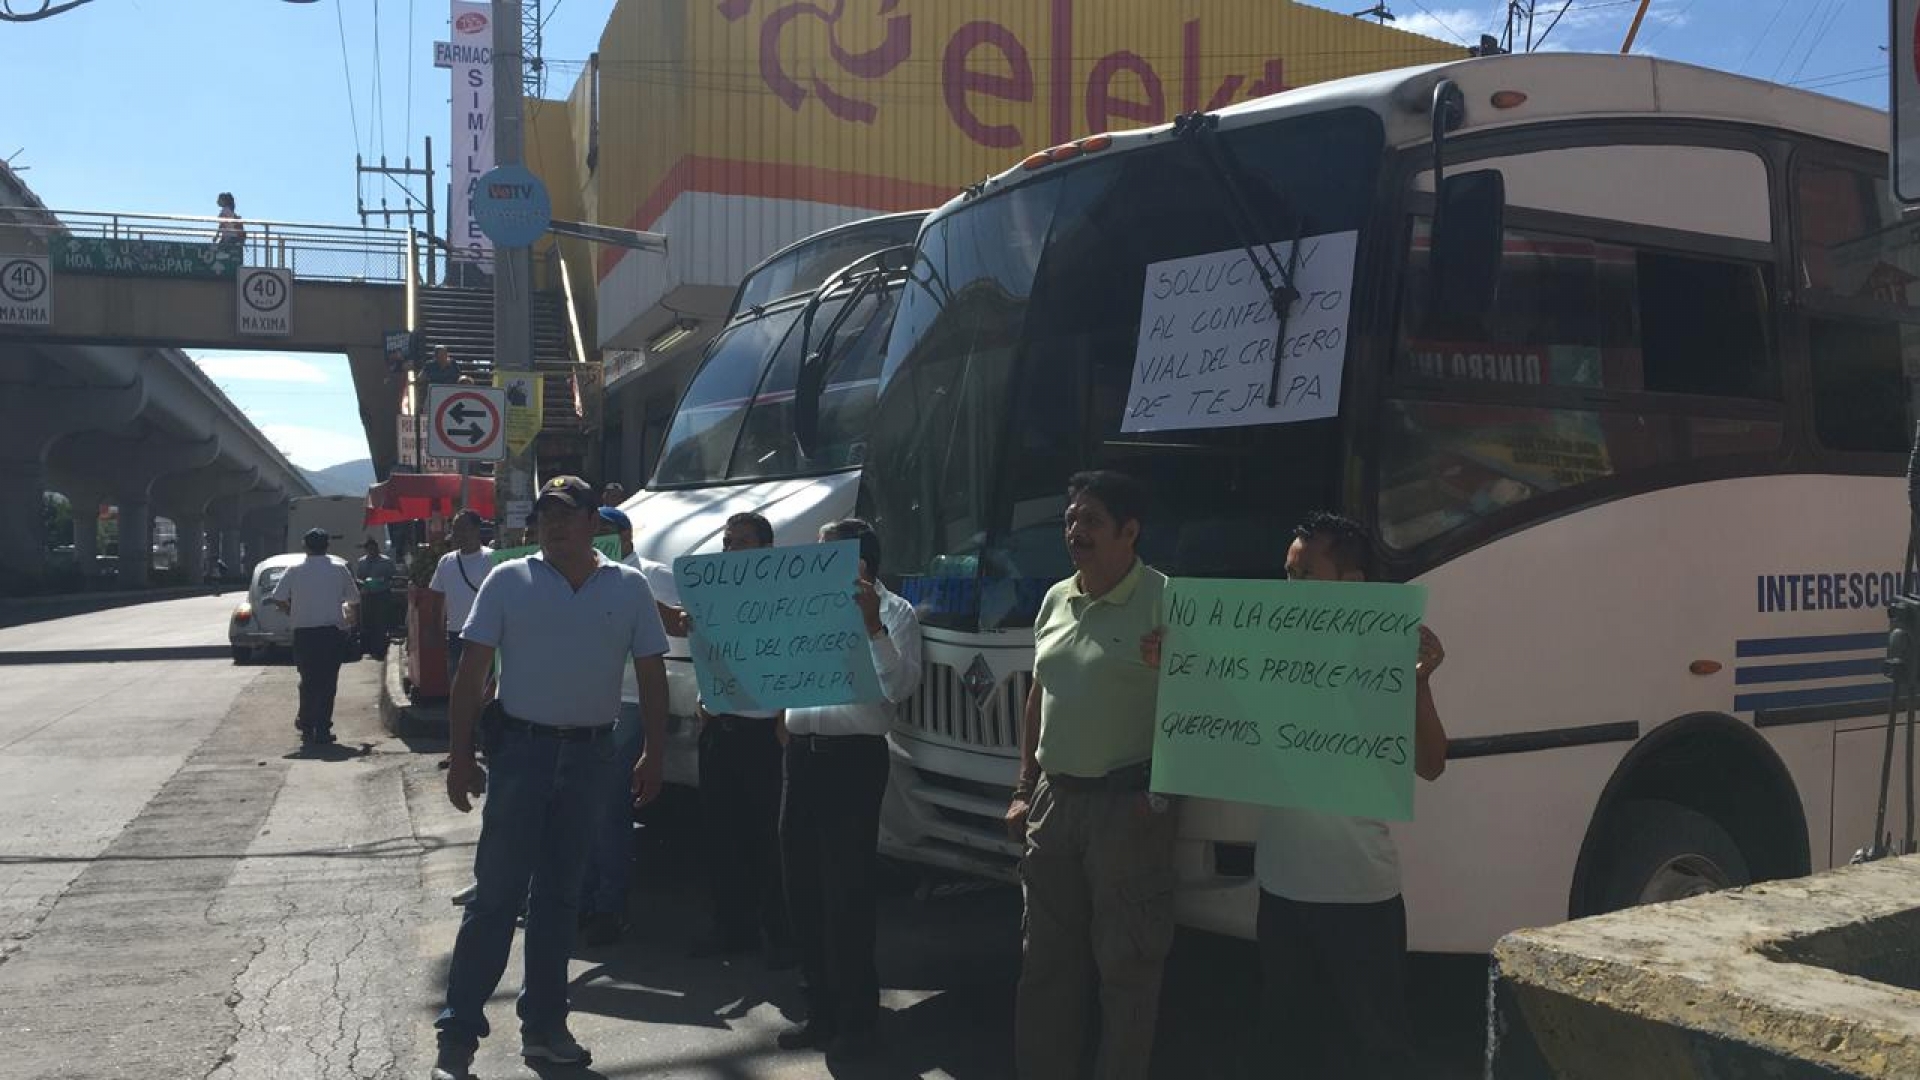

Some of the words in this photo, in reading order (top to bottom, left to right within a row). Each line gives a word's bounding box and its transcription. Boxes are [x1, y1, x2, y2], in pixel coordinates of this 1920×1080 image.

[11, 267, 35, 286] 40
[253, 279, 276, 297] 40
[0, 306, 47, 321] MAXIMA
[242, 316, 287, 331] MAXIMA
[1150, 314, 1175, 340] AL
[1191, 290, 1342, 334] CONFLITO
[1140, 352, 1189, 385] VIAL
[1198, 347, 1228, 375] DEL
[1131, 394, 1171, 418] DE
[1187, 374, 1322, 415] TEJAPA
[683, 551, 838, 588] SOLUCION
[737, 590, 847, 625] CONFLICTO
[1169, 592, 1197, 627] NO
[1208, 597, 1224, 626] A
[1234, 601, 1262, 628] LA
[1267, 604, 1421, 637] GENERACION
[754, 637, 782, 657] DEL
[713, 677, 737, 697] DE
[759, 671, 855, 694] TEJALPA
[1167, 653, 1198, 676] DE
[1205, 656, 1249, 680] MAS
[1259, 658, 1404, 693] PROBLEMAS
[1160, 711, 1261, 746] QUEREMOS
[1276, 723, 1407, 765] SOLUCIONES
